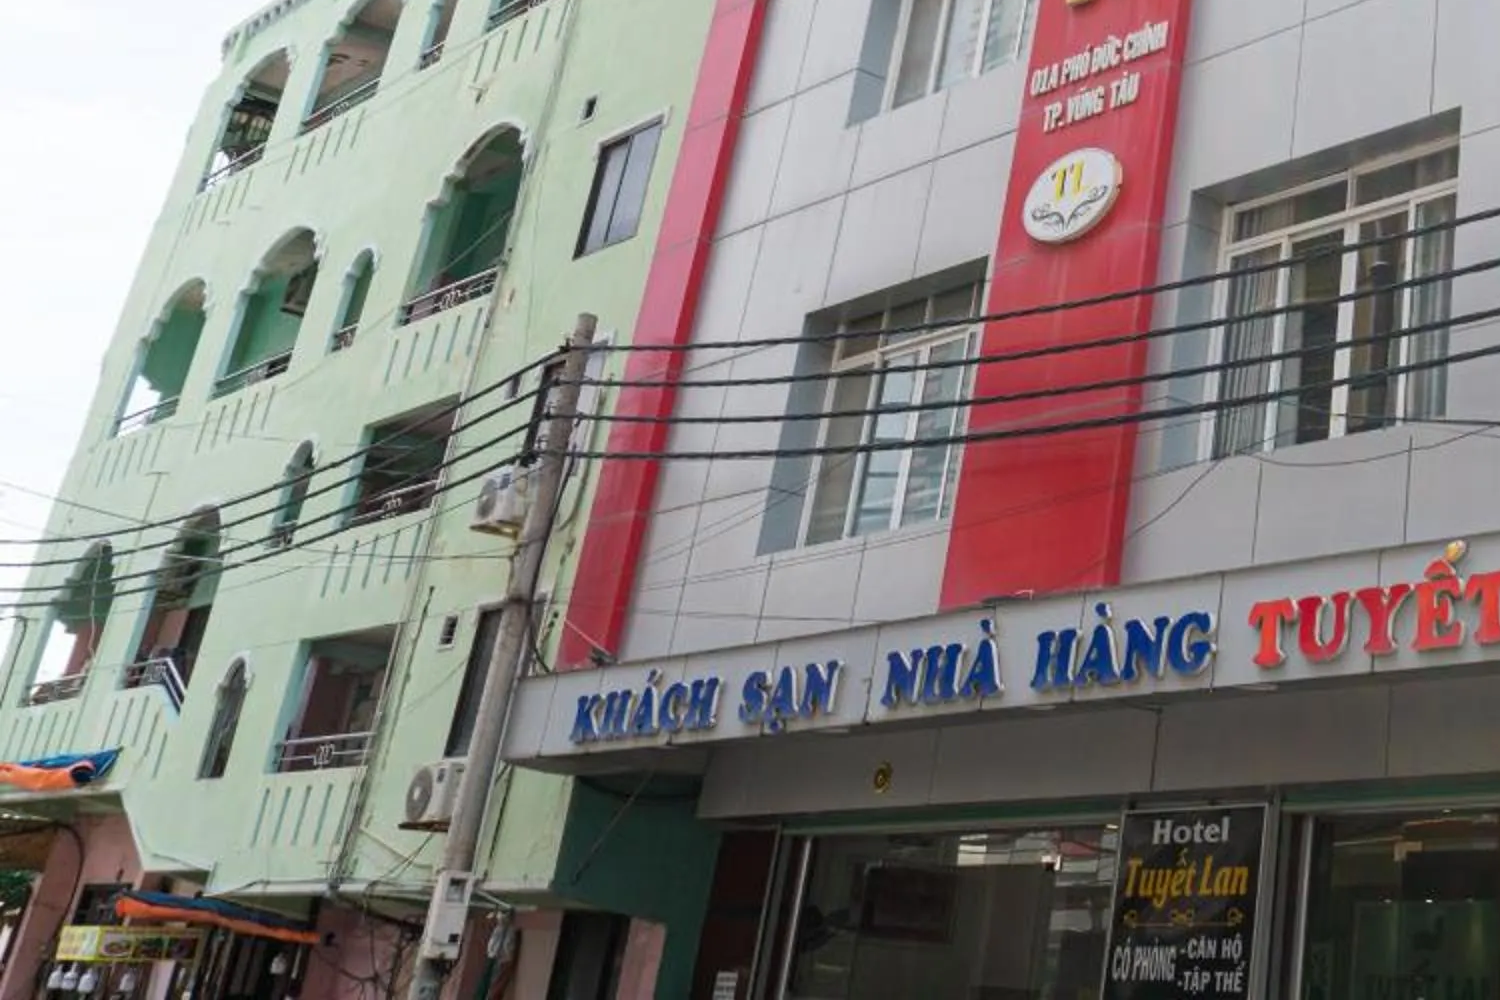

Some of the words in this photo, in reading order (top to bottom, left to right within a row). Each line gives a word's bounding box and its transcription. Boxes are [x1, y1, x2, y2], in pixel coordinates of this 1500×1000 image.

[569, 668, 725, 746] KHÁCH
[738, 659, 845, 734] SẠN
[880, 618, 1004, 707] NHÀ
[1029, 601, 1218, 695] HÀNG
[1152, 816, 1231, 845] Hotel
[1124, 847, 1198, 909] Tuyết
[1198, 855, 1249, 897] Lan
